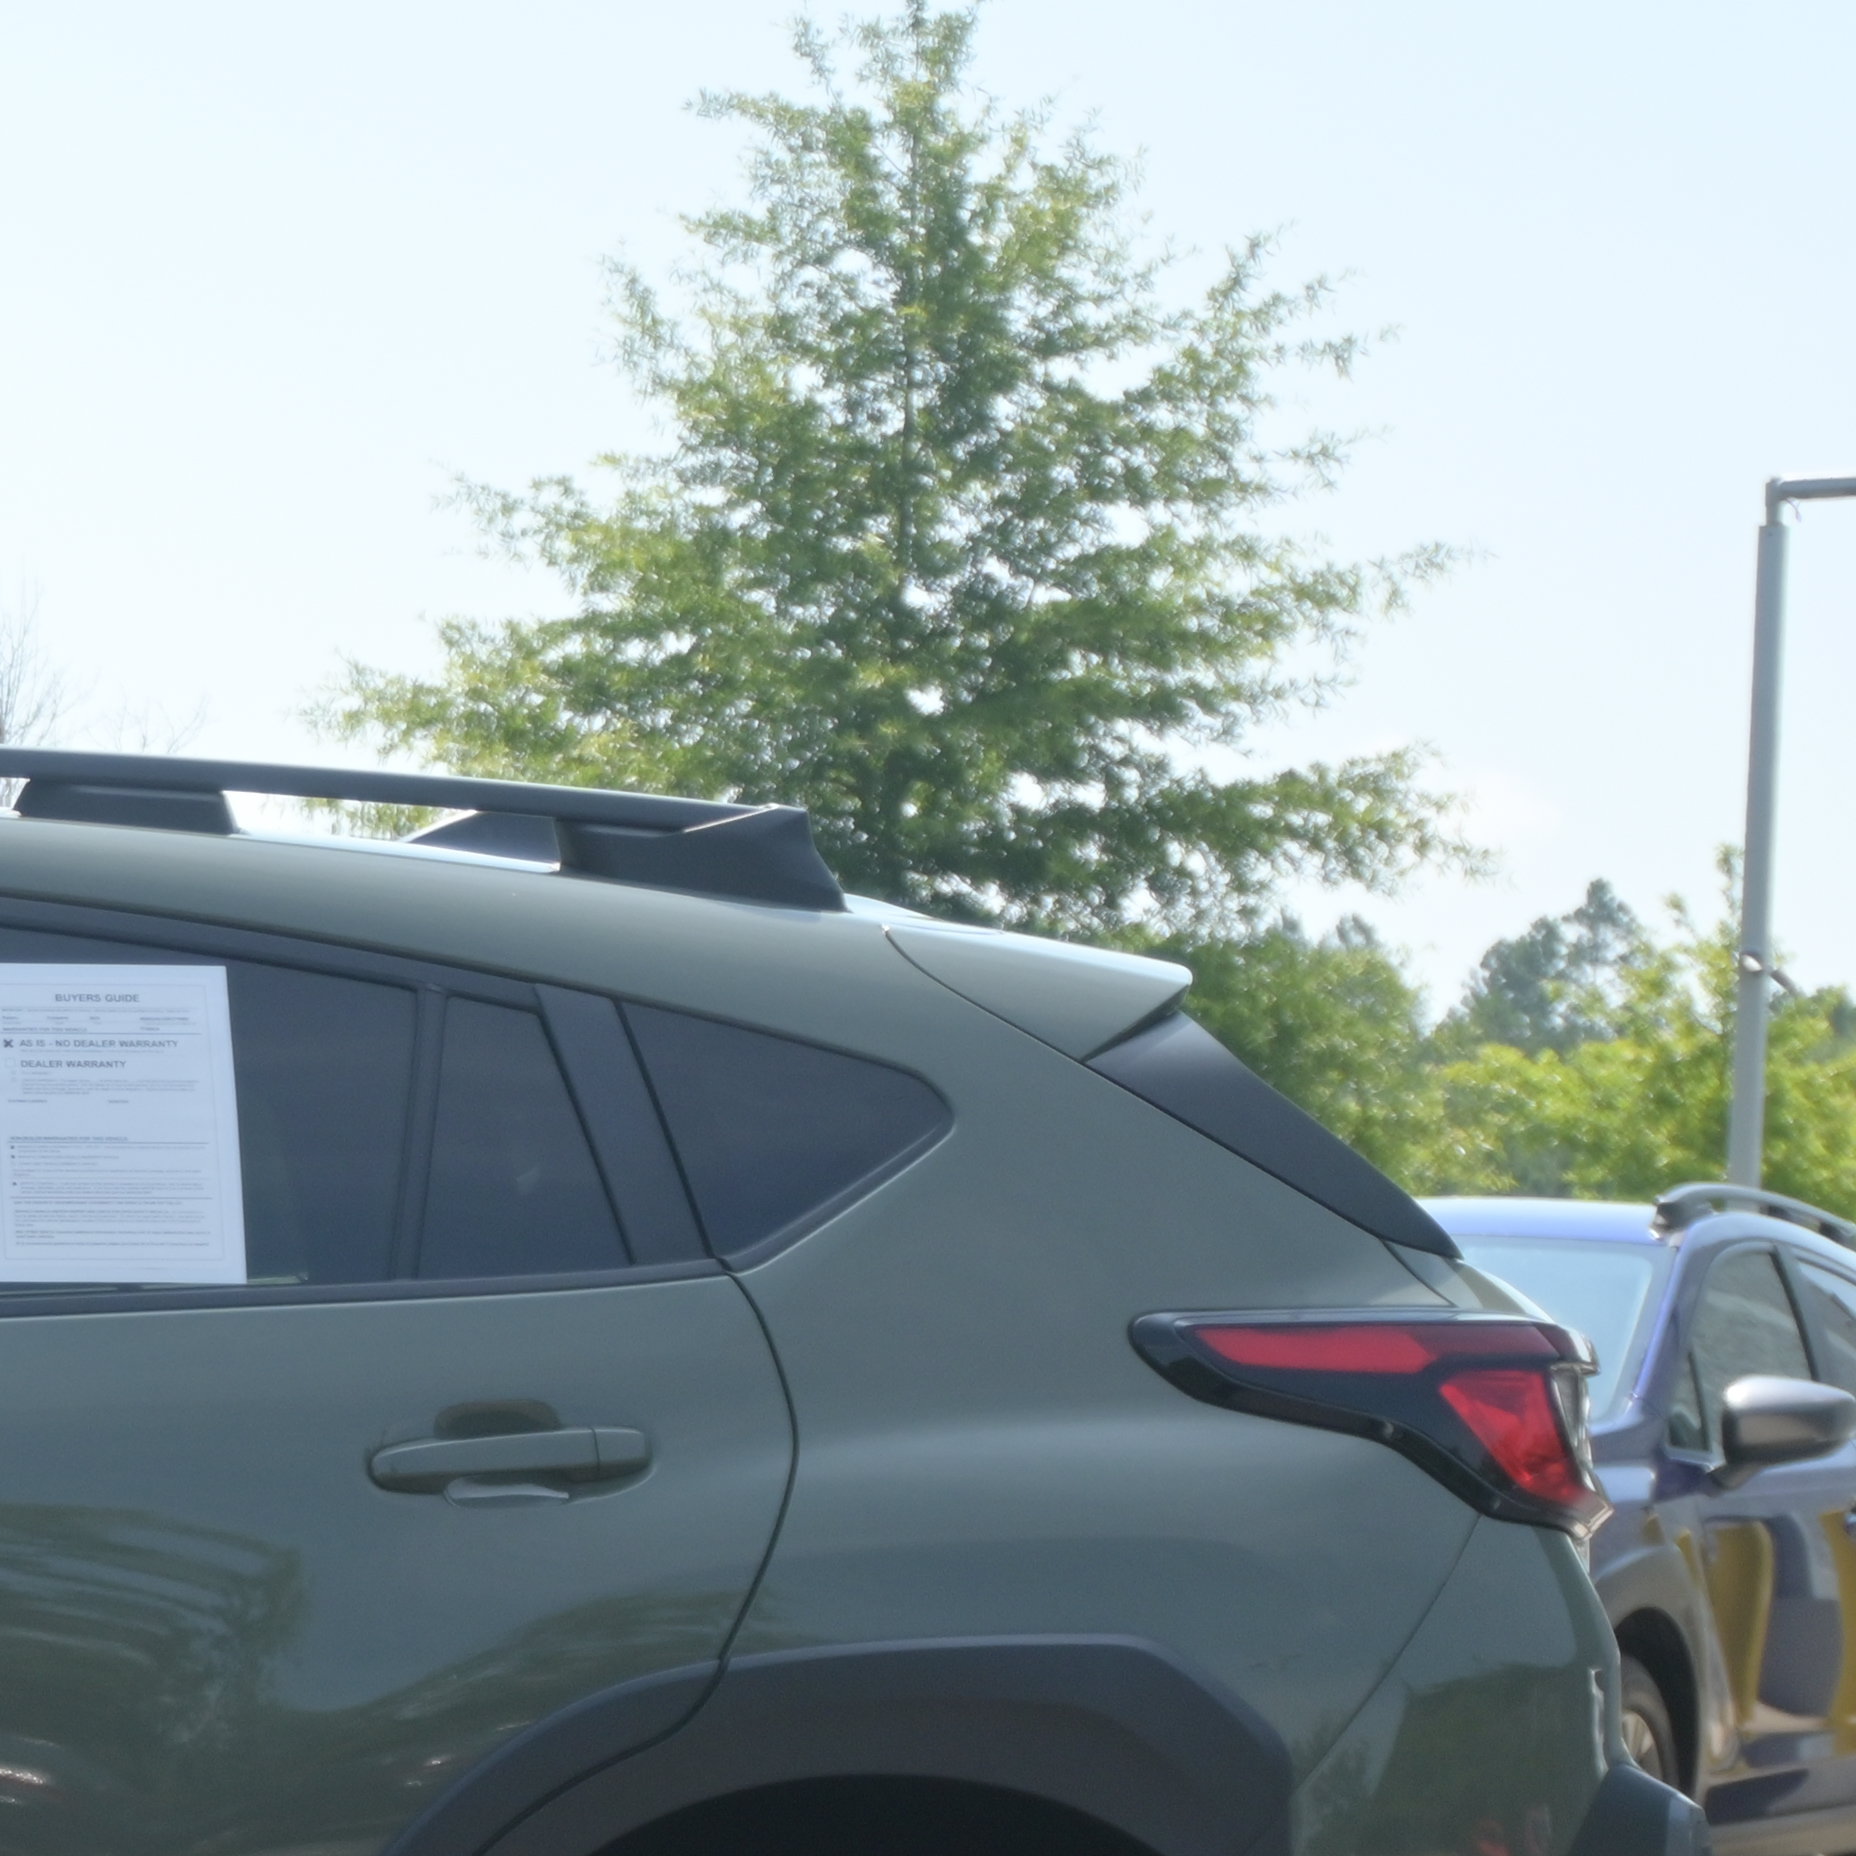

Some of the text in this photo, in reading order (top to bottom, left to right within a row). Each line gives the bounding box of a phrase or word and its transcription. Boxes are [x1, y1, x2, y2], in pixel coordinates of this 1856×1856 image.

[54, 993, 140, 1002] BUYERS GUIDE
[19, 1039, 33, 1047] AS
[36, 1039, 46, 1047] IS
[55, 1039, 71, 1048] NO
[73, 1039, 116, 1048] DEALER
[119, 1040, 179, 1048] WARRANTY
[20, 1060, 127, 1068] DEALER WARRANTY
